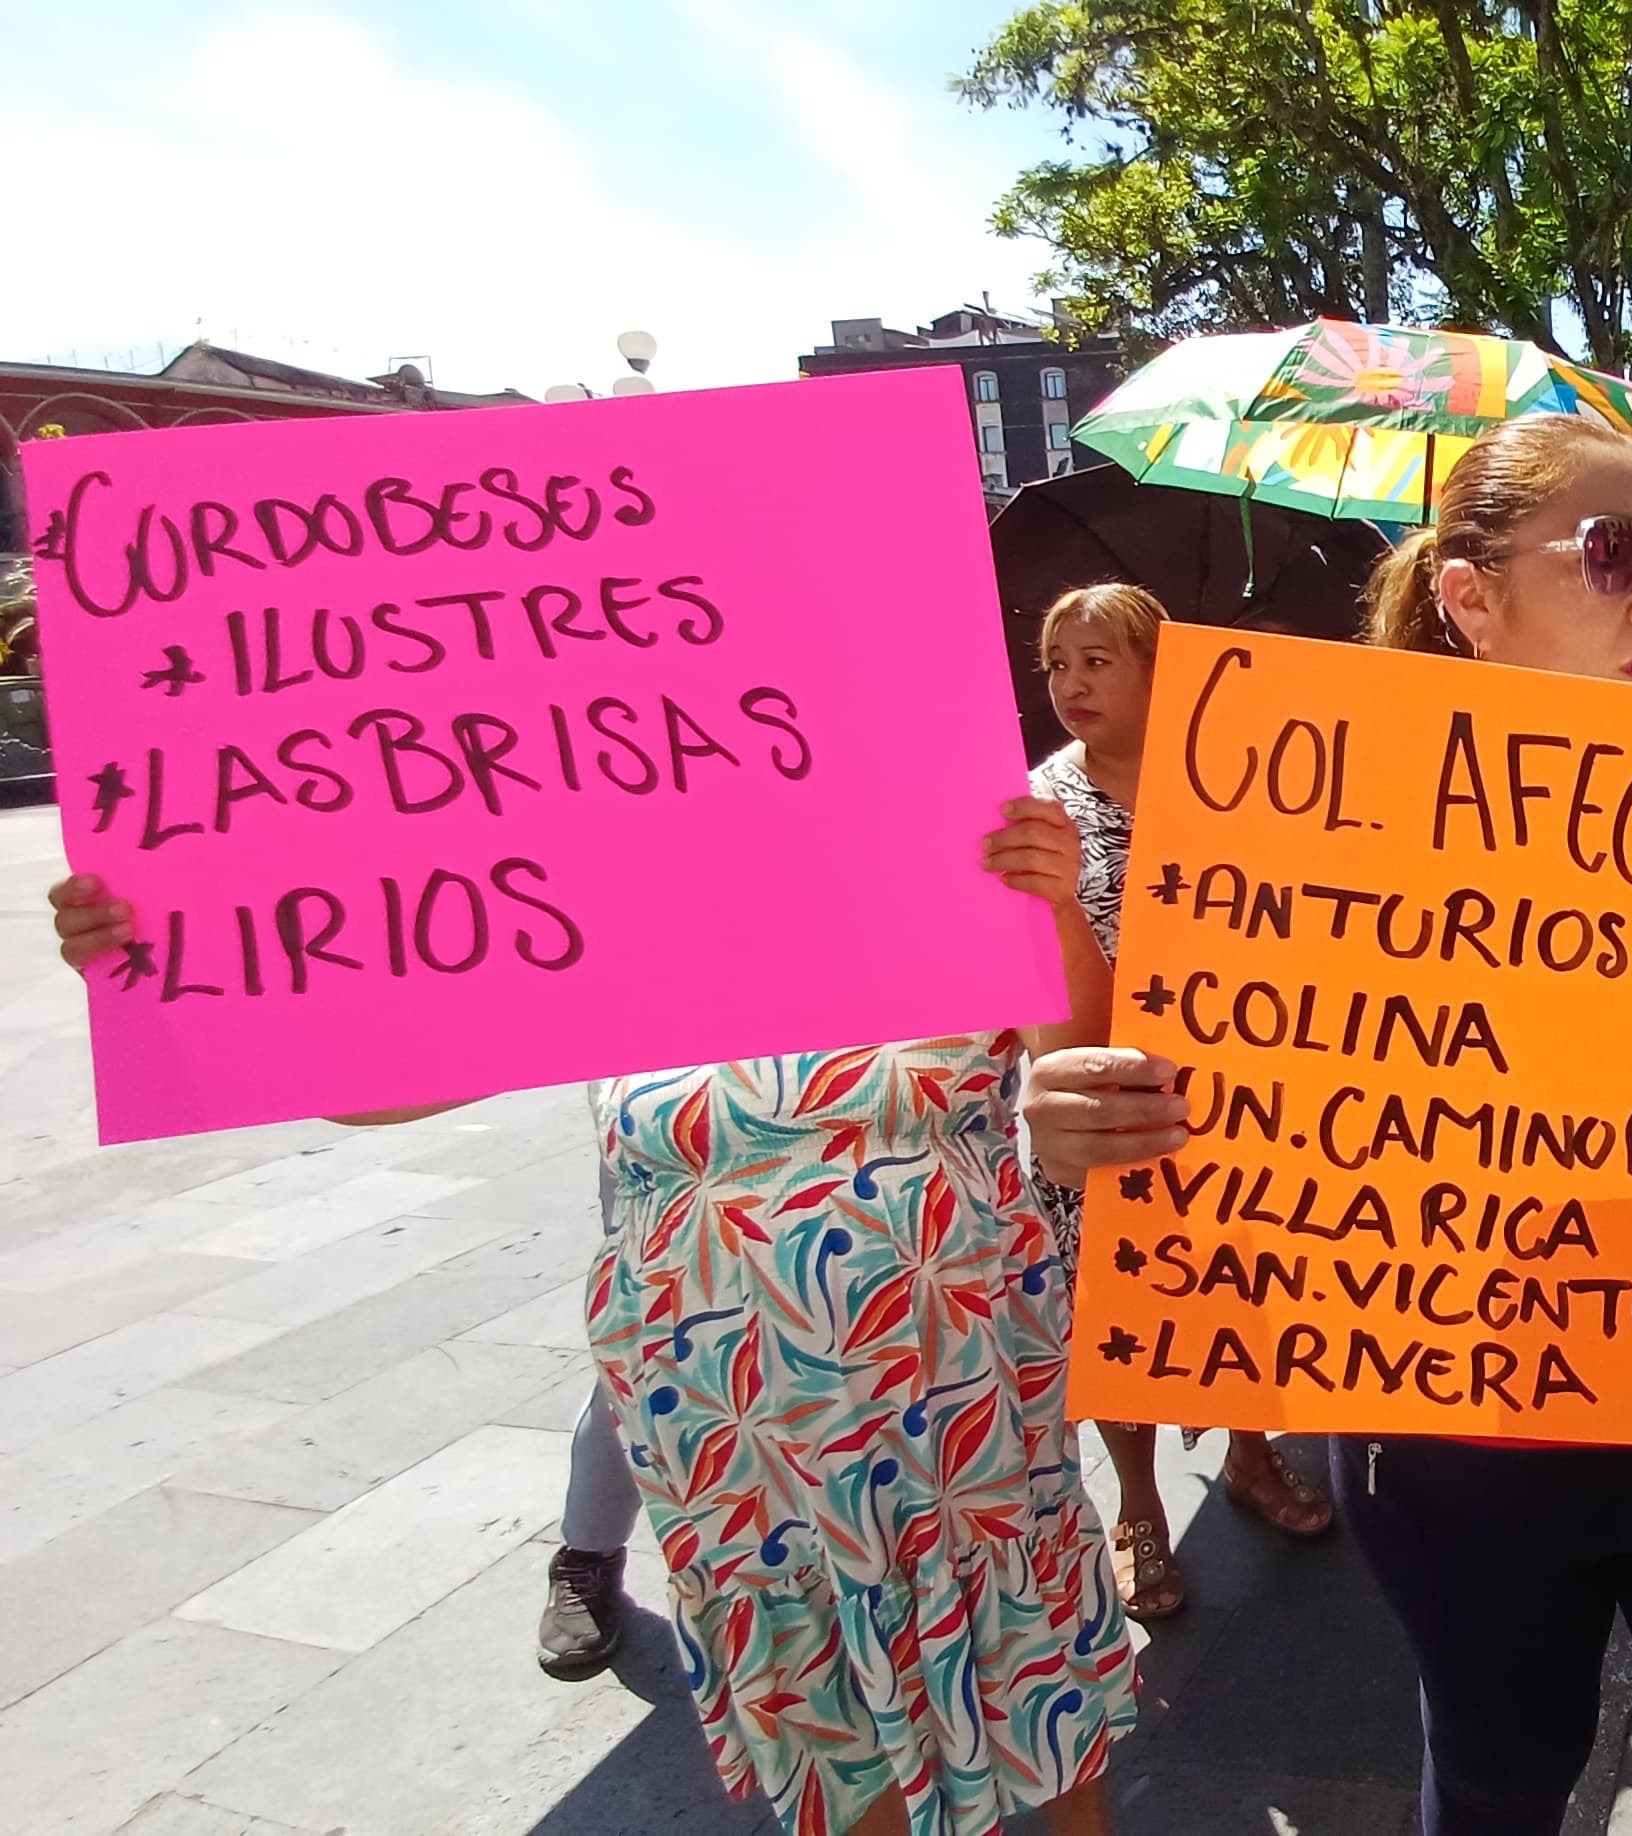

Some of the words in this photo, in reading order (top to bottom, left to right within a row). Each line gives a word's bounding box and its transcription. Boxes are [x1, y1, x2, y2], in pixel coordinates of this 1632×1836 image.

[228, 575, 725, 695] ILUSTRES
[1185, 647, 1384, 831] COL.
[160, 857, 585, 1002] LIRIOS
[1193, 864, 1628, 979] ANTURIOS
[1180, 971, 1510, 1075] COLINA
[1159, 1158, 1397, 1250] VILLA
[1421, 1182, 1600, 1260] RICA
